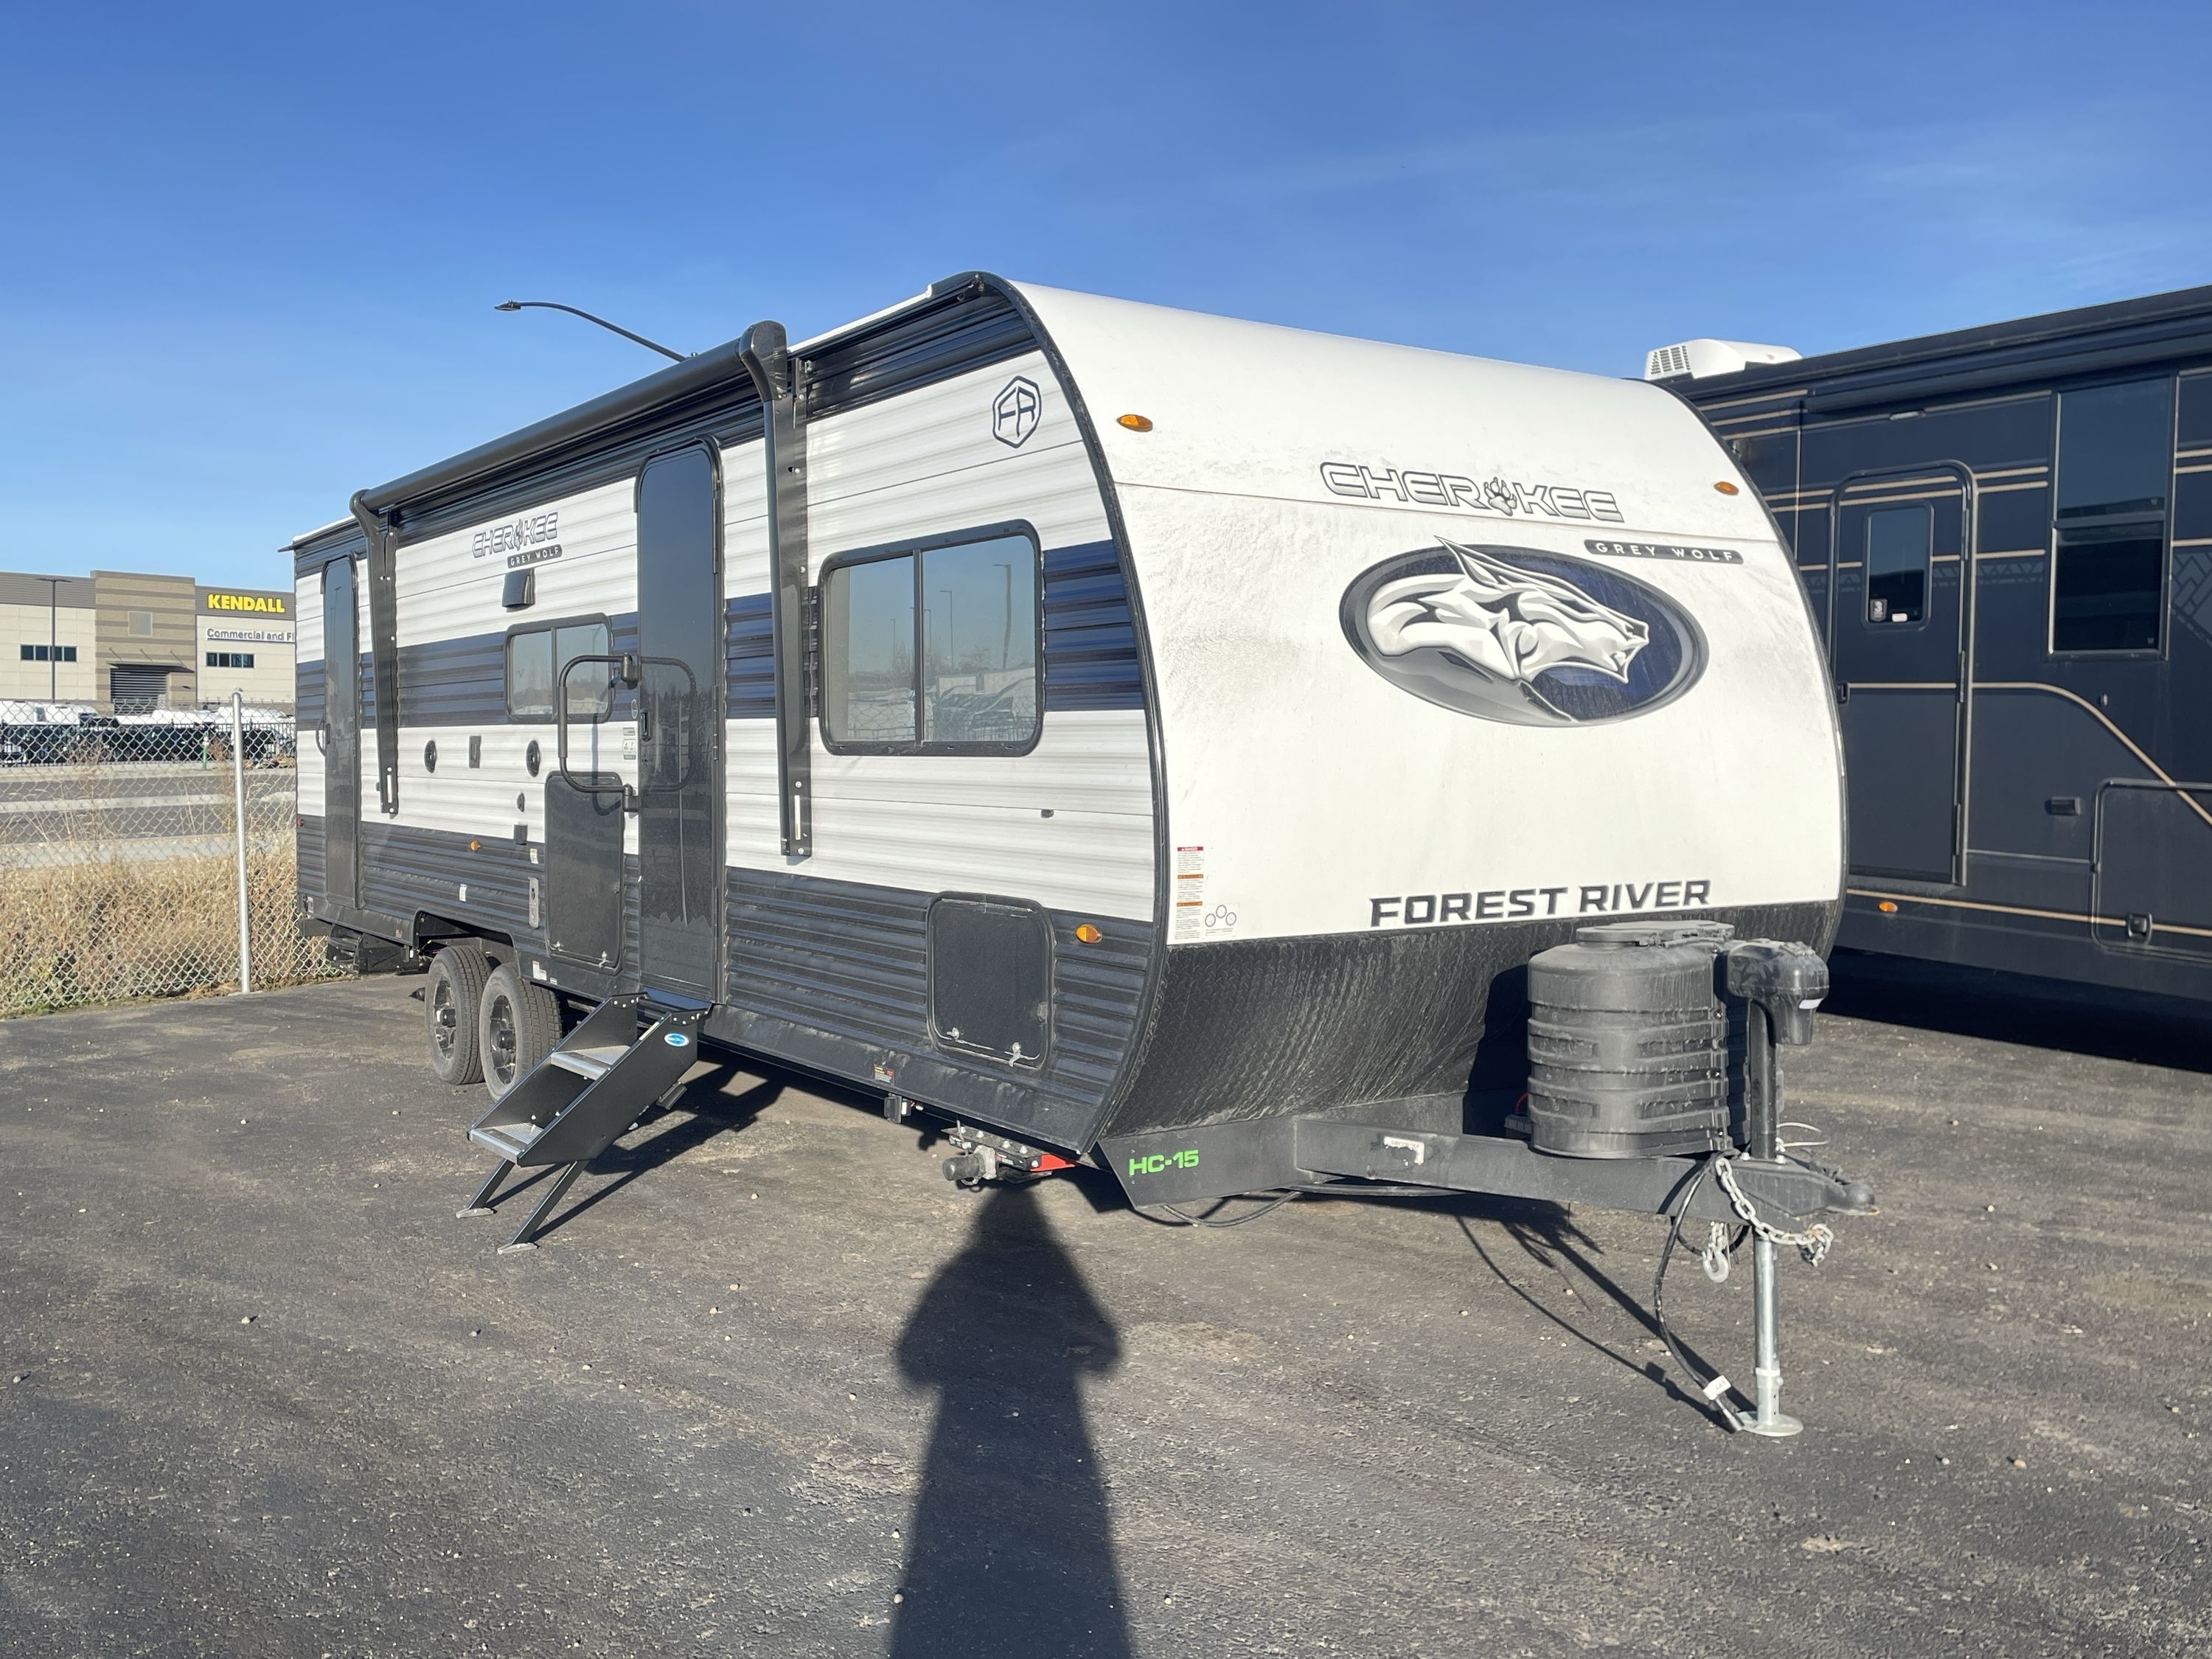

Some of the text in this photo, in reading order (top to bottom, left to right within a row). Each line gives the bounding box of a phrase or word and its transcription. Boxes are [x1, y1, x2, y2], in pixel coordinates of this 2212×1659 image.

[510, 546, 560, 566] GREY WOLF
[1596, 542, 1733, 561] GREY WOLF
[207, 594, 285, 613] KENDALL
[206, 628, 264, 640] Commercial
[266, 633, 284, 641] and
[1368, 879, 1712, 928] FOREST RIVER
[1129, 1150, 1200, 1176] HC-15
